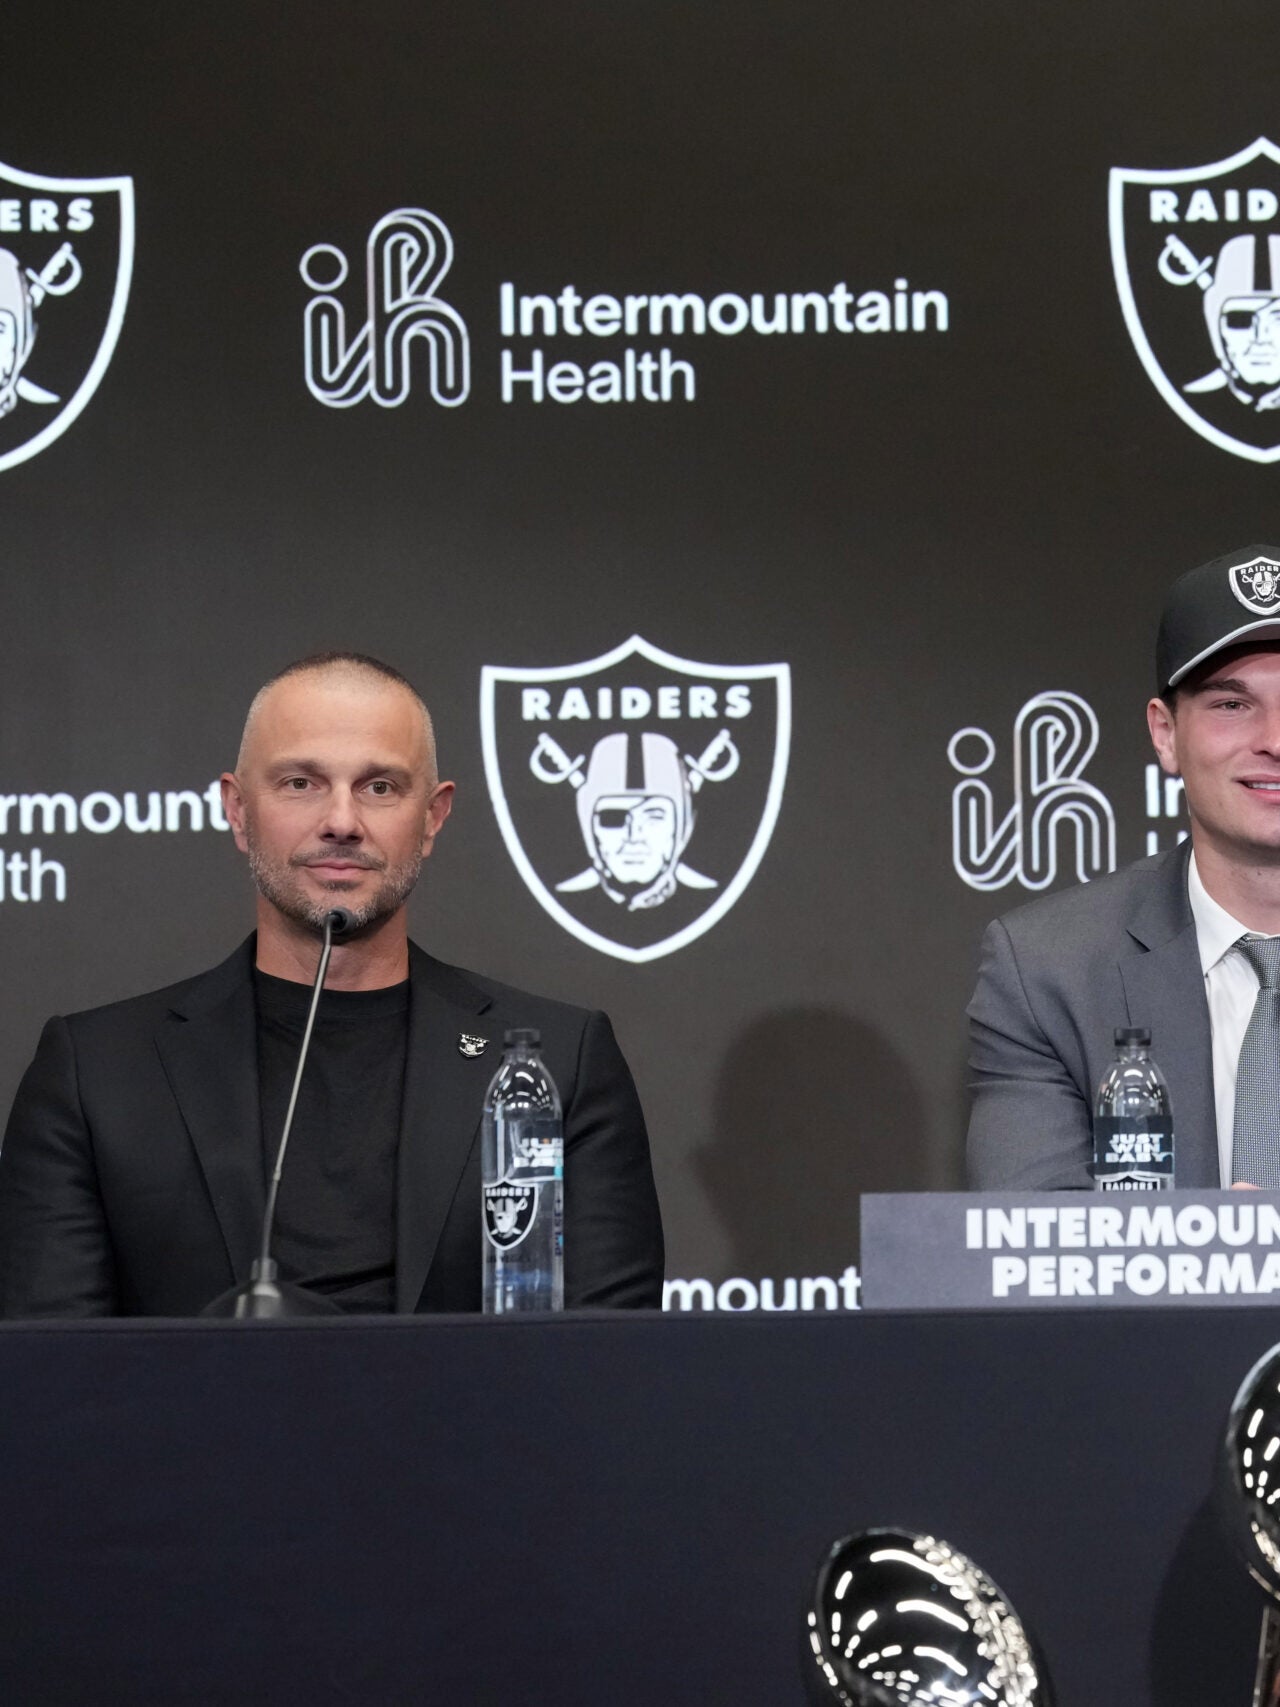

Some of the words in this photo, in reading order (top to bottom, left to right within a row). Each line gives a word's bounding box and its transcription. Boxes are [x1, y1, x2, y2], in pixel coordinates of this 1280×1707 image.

[500, 277, 949, 337] Intermountain
[500, 347, 696, 404] Health
[521, 684, 752, 722] RAIDERS
[1109, 1133, 1164, 1144] JUST
[1110, 1144, 1160, 1153] WIN
[1105, 1152, 1165, 1163] BABY
[1105, 1181, 1154, 1191] RAIDERS
